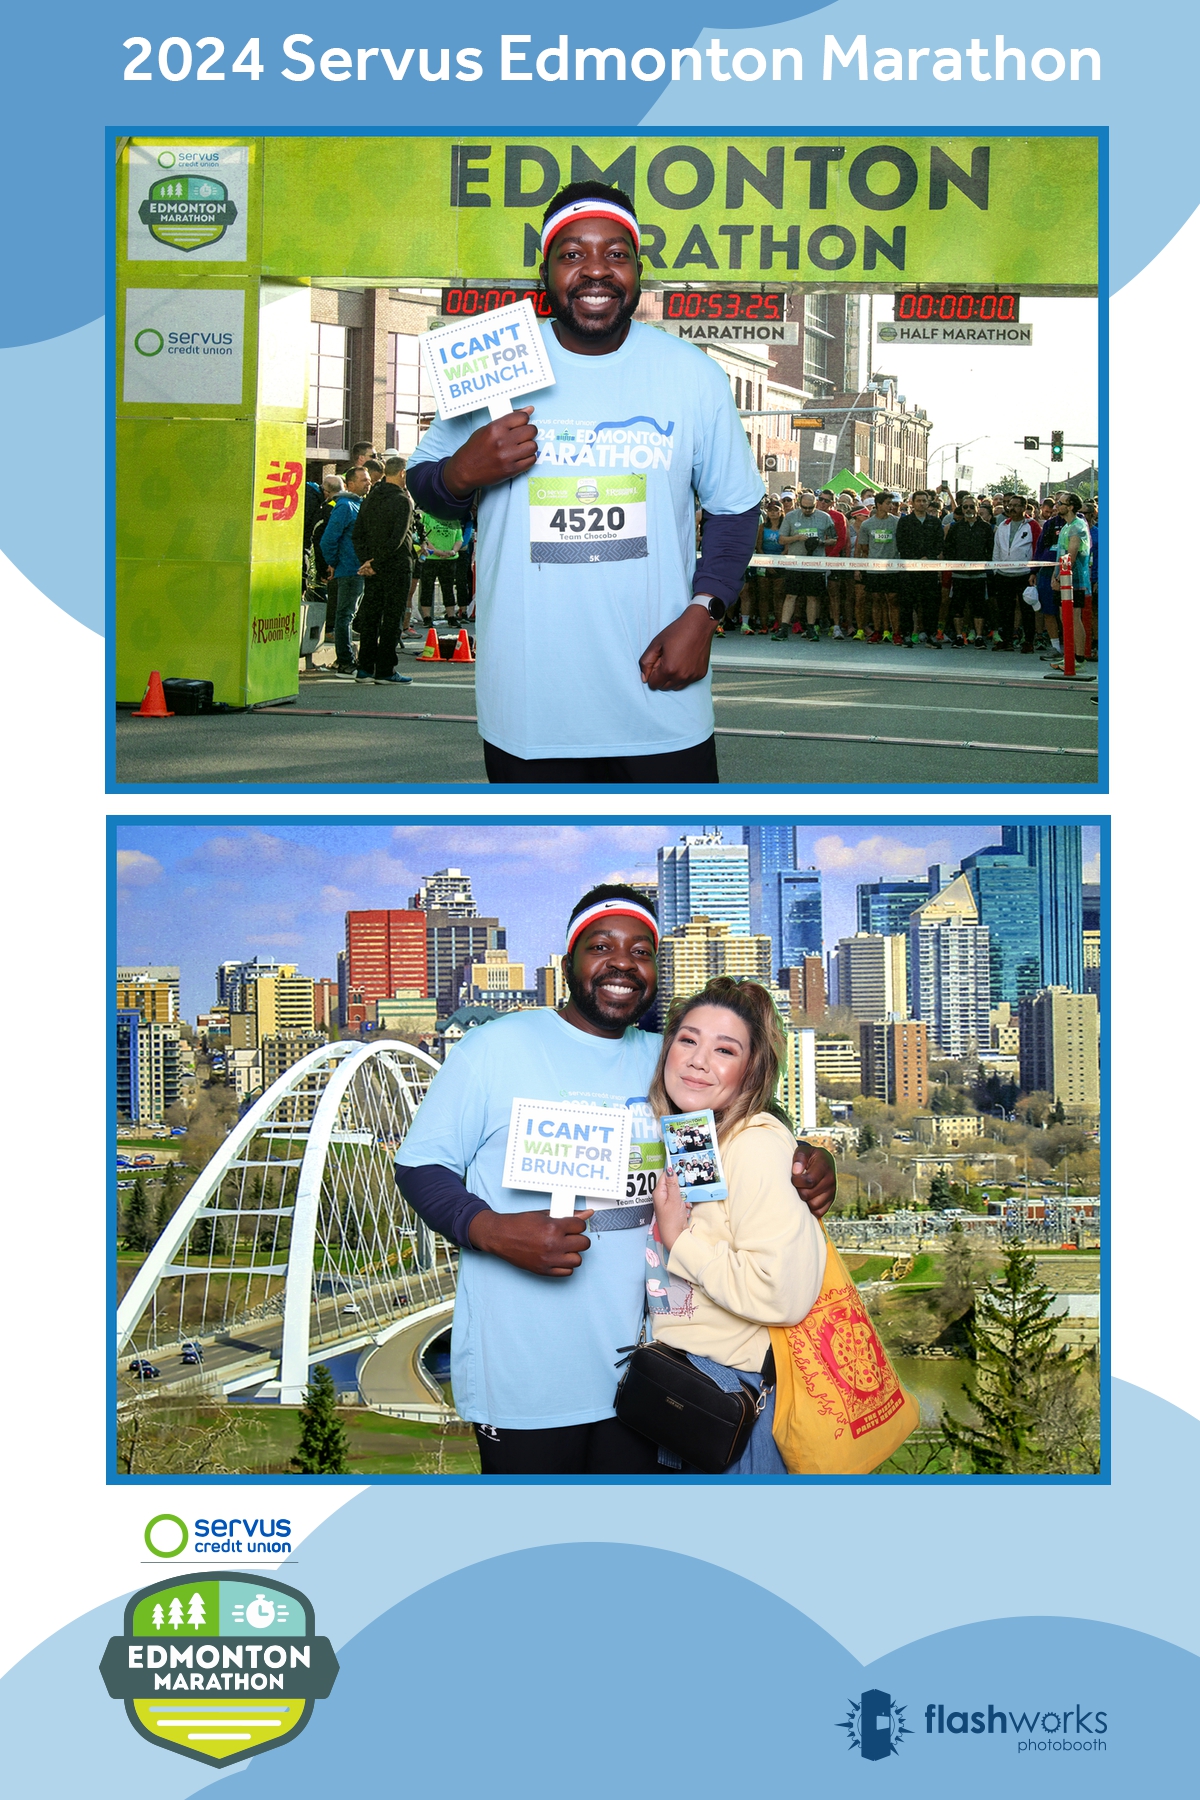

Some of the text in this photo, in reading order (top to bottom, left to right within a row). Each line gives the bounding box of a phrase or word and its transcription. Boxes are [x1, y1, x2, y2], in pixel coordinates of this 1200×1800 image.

[179, 151, 219, 161] servus
[450, 144, 990, 211] EDMONTON
[149, 203, 226, 214] EDMONTON
[160, 214, 215, 222] MARATHON
[523, 222, 906, 271] RATHON
[168, 332, 233, 345] servus
[439, 323, 520, 364] I CAN'T
[679, 325, 785, 340] MARATHON
[900, 328, 1031, 341] HALF MARATHON
[168, 345, 233, 355] credit union
[443, 343, 529, 381] WAIT FOR
[449, 361, 534, 399] BRUNCH.
[553, 418, 574, 426] credit
[576, 429, 674, 449] EDMONTON
[535, 442, 673, 471] ARATHON
[549, 506, 625, 532] 4520
[584, 532, 617, 540] Chocobo
[257, 613, 290, 642] Running
[526, 1118, 533, 1135] I
[538, 1120, 614, 1144] CAN'T
[523, 1139, 612, 1162] WAIT FOR
[521, 1157, 609, 1180] BRUNCH.
[626, 1171, 657, 1197] 520
[856, 1398, 903, 1435] PARTY REWARD
[863, 1398, 894, 1423] THE PIZZA
